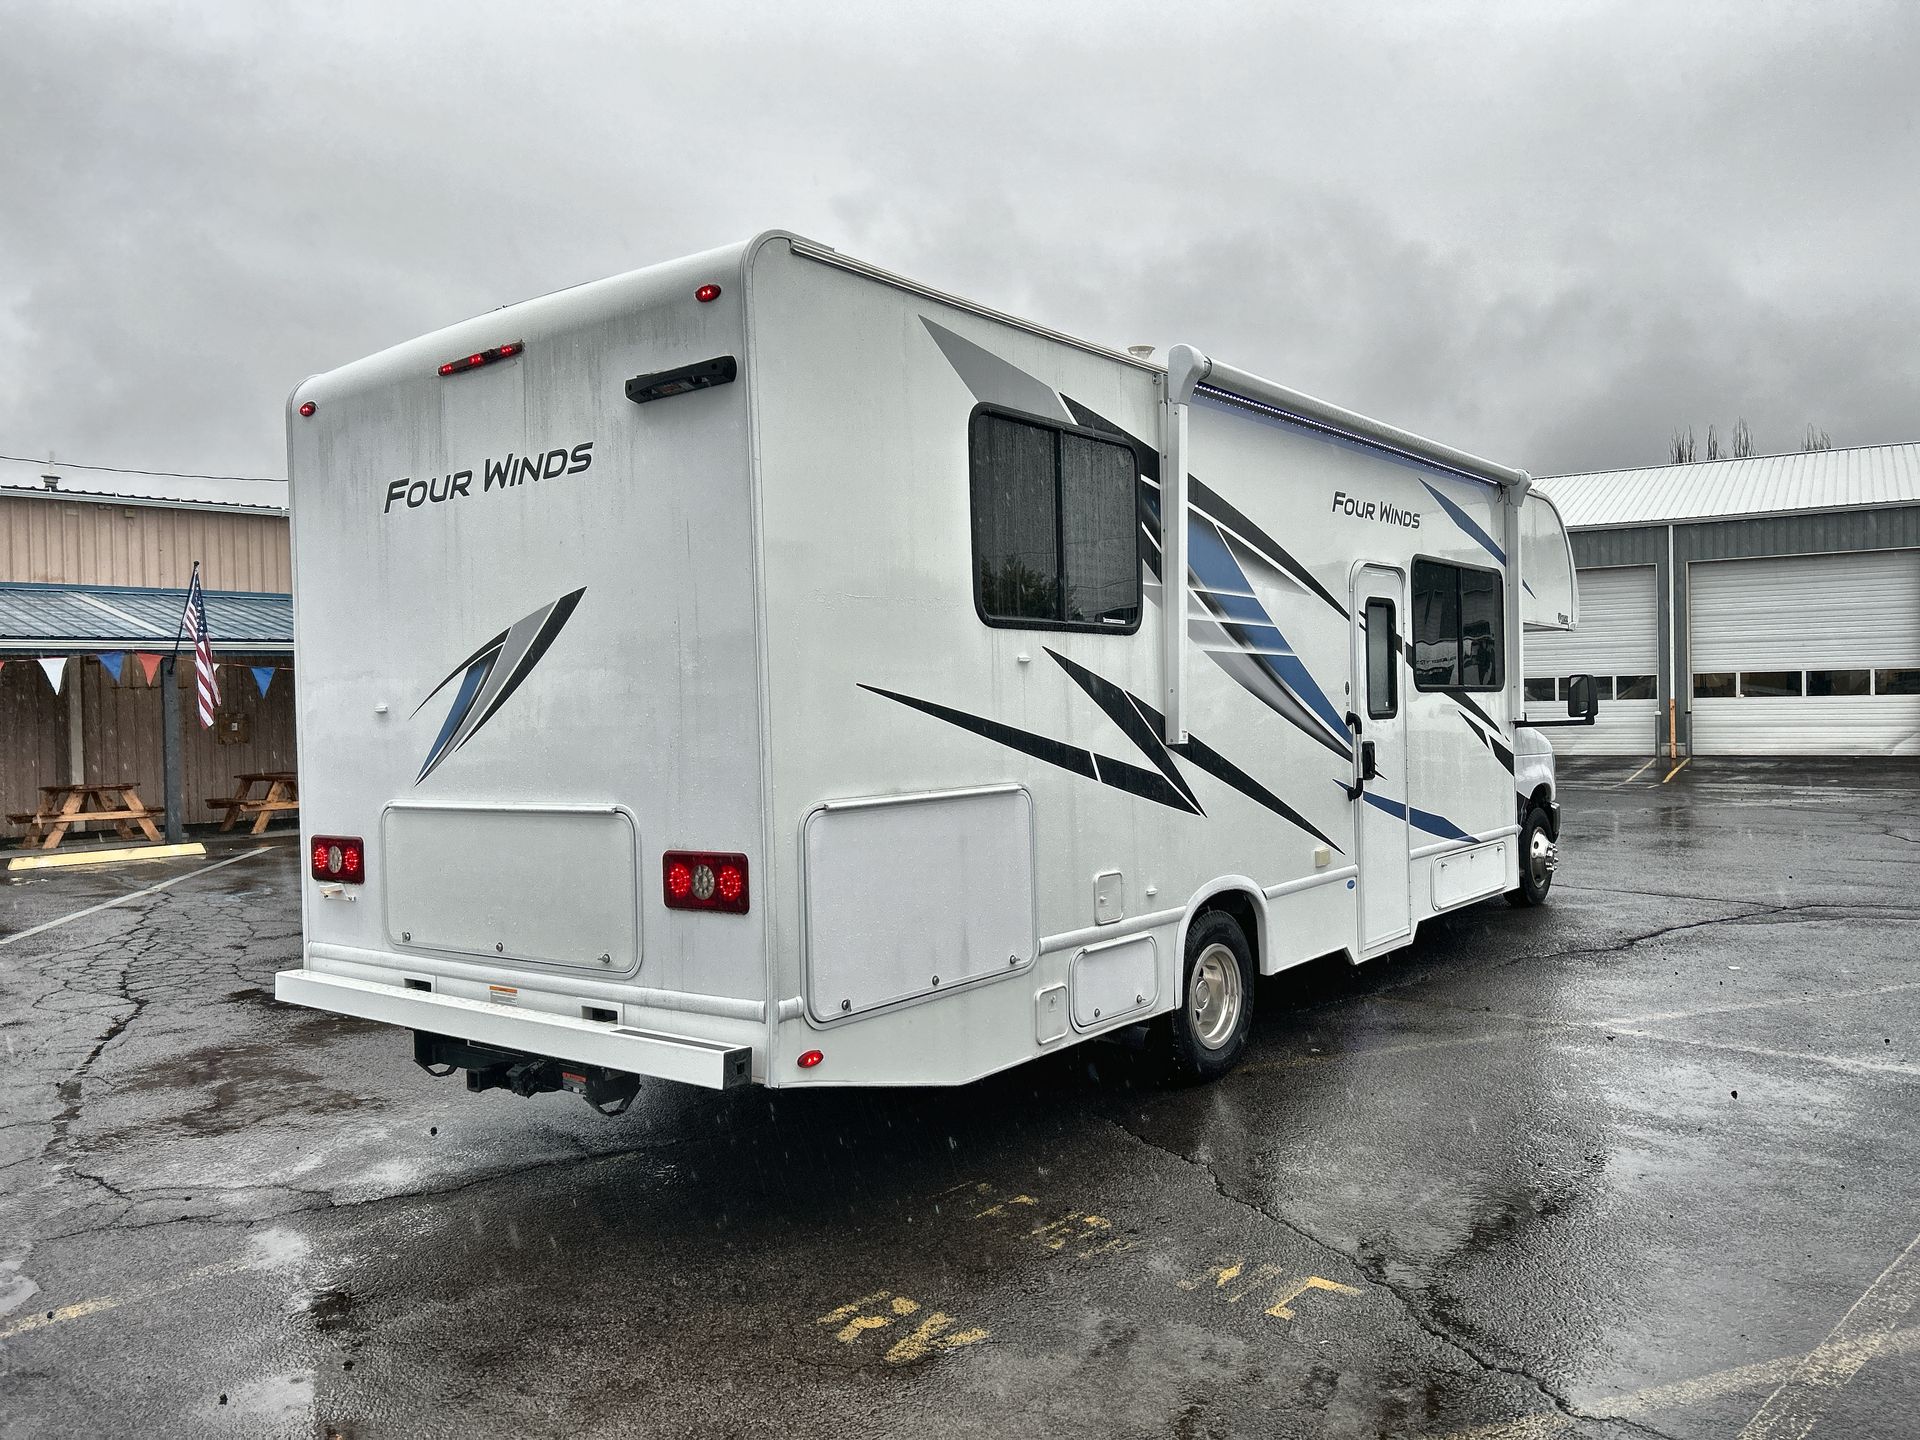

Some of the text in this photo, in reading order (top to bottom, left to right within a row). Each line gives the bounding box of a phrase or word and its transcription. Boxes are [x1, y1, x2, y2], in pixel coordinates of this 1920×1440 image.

[384, 442, 594, 514] FOUR WINDS
[1332, 491, 1420, 529] FOUR WINDS
